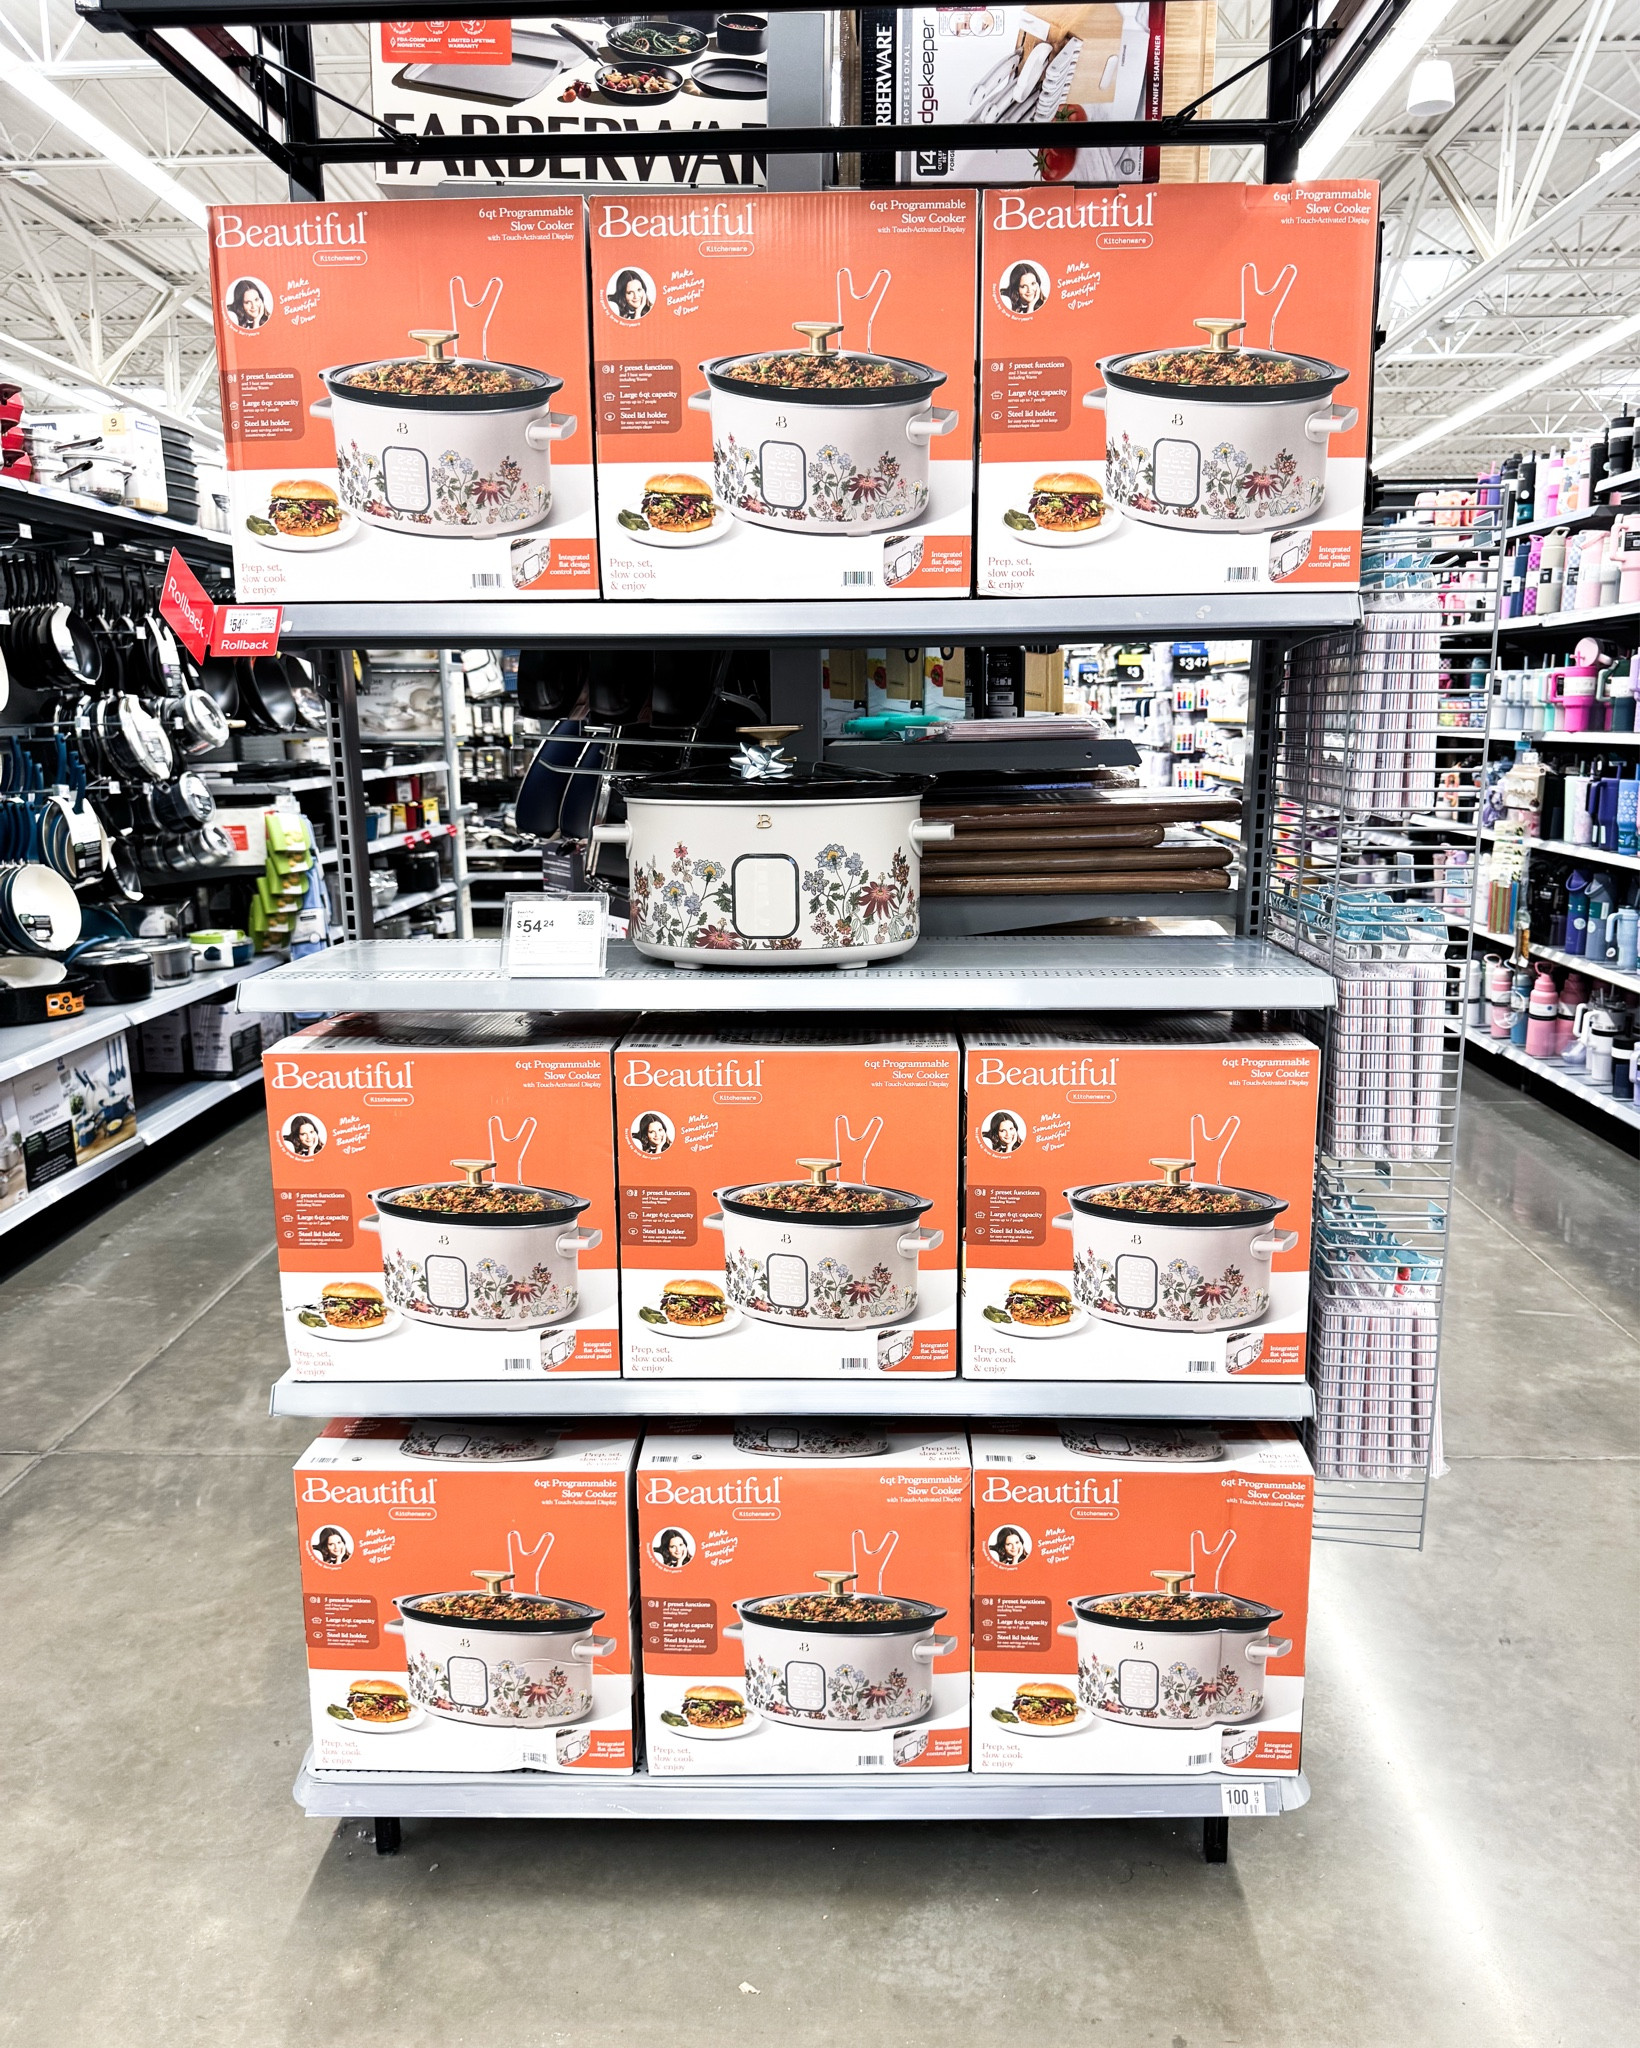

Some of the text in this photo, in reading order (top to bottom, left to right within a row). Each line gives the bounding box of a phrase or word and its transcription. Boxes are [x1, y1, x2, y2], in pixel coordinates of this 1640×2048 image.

[920, 150, 936, 173] 14
[1273, 189, 1373, 202] 6qt Programmable
[870, 198, 966, 212] 6qt Programmable
[1306, 203, 1373, 214] Slow Cooker
[478, 205, 574, 220] 6qt Programmable
[993, 193, 1154, 230] Beautiful
[598, 203, 754, 237] Beautiful
[902, 213, 966, 223] Slow Cooker
[215, 212, 367, 247] Beautiful
[510, 220, 575, 231] Slow Cooker
[320, 254, 361, 262] Kitchenware
[1066, 261, 1091, 274] Make
[671, 268, 694, 280] Make
[1056, 271, 1101, 288] Something
[663, 278, 705, 295] Something
[652, 391, 677, 399] capacity
[111, 418, 118, 427] 9
[168, 576, 205, 638] Rollback
[221, 640, 269, 650] Rollback
[756, 814, 772, 829] B
[515, 1059, 601, 1070] 6qt Programmable
[864, 1059, 949, 1069] 6qt Programmable
[1222, 1057, 1310, 1068] 6qt Programmable
[272, 1061, 414, 1089] Beautiful
[544, 1071, 602, 1080] Slow Cooker
[623, 1059, 763, 1087] Beautiful
[892, 1070, 949, 1079] Slow Cooker
[975, 1057, 1117, 1085] Beautiful
[1251, 1069, 1310, 1078] Slow Cooker
[534, 1479, 617, 1489] 6qt Programmable
[880, 1475, 962, 1485] 6qt Programmable
[1238, 1478, 1305, 1490] Programmable
[301, 1477, 437, 1504] Beautiful
[562, 1489, 617, 1498] Slow Cooker
[645, 1476, 781, 1504] Beautiful
[907, 1486, 963, 1495] Slow Cooker
[982, 1477, 1120, 1504] Beautiful
[1247, 1490, 1306, 1500] Slow Cooker
[1226, 1789, 1249, 1804] 100
